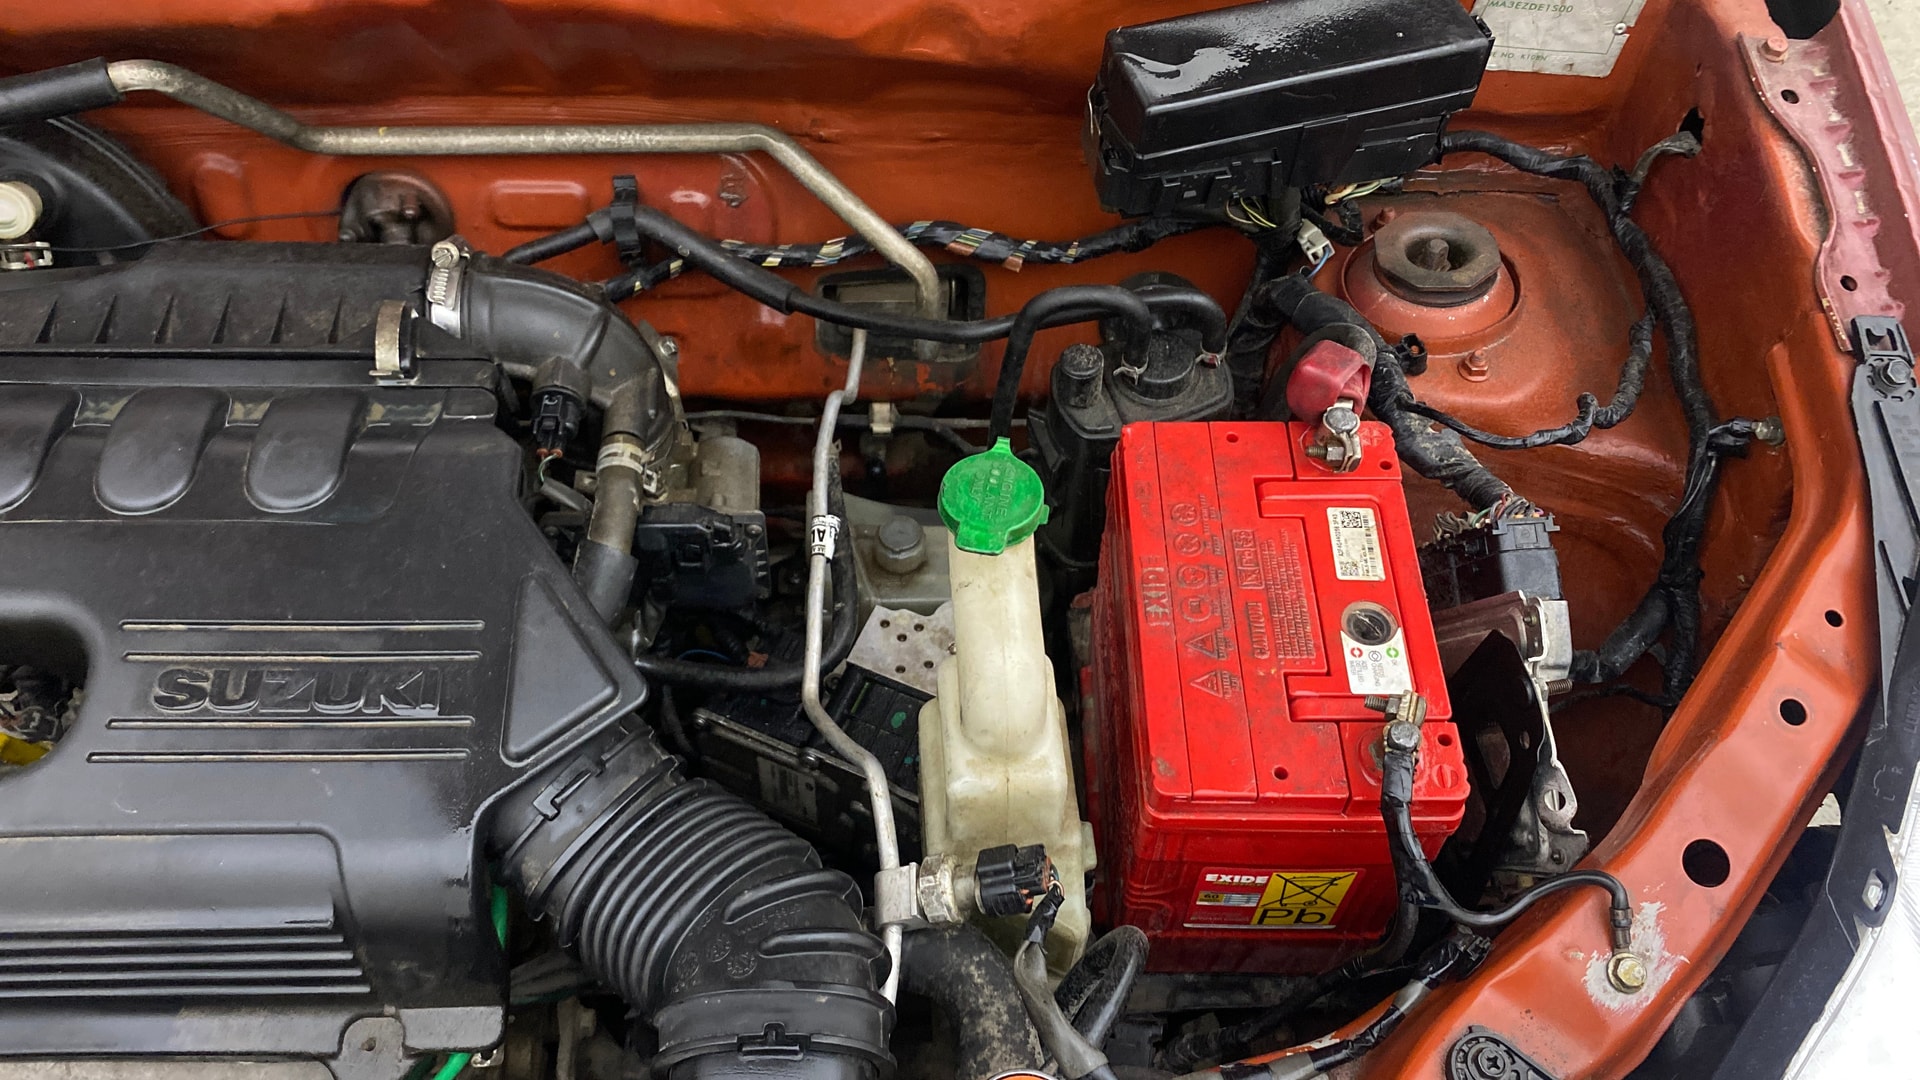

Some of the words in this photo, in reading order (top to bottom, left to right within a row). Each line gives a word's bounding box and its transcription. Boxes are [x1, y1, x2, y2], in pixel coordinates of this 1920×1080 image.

[152, 667, 440, 717] SUZUKI
[1205, 873, 1270, 883] EXIDE
[1257, 908, 1327, 925] Pb
